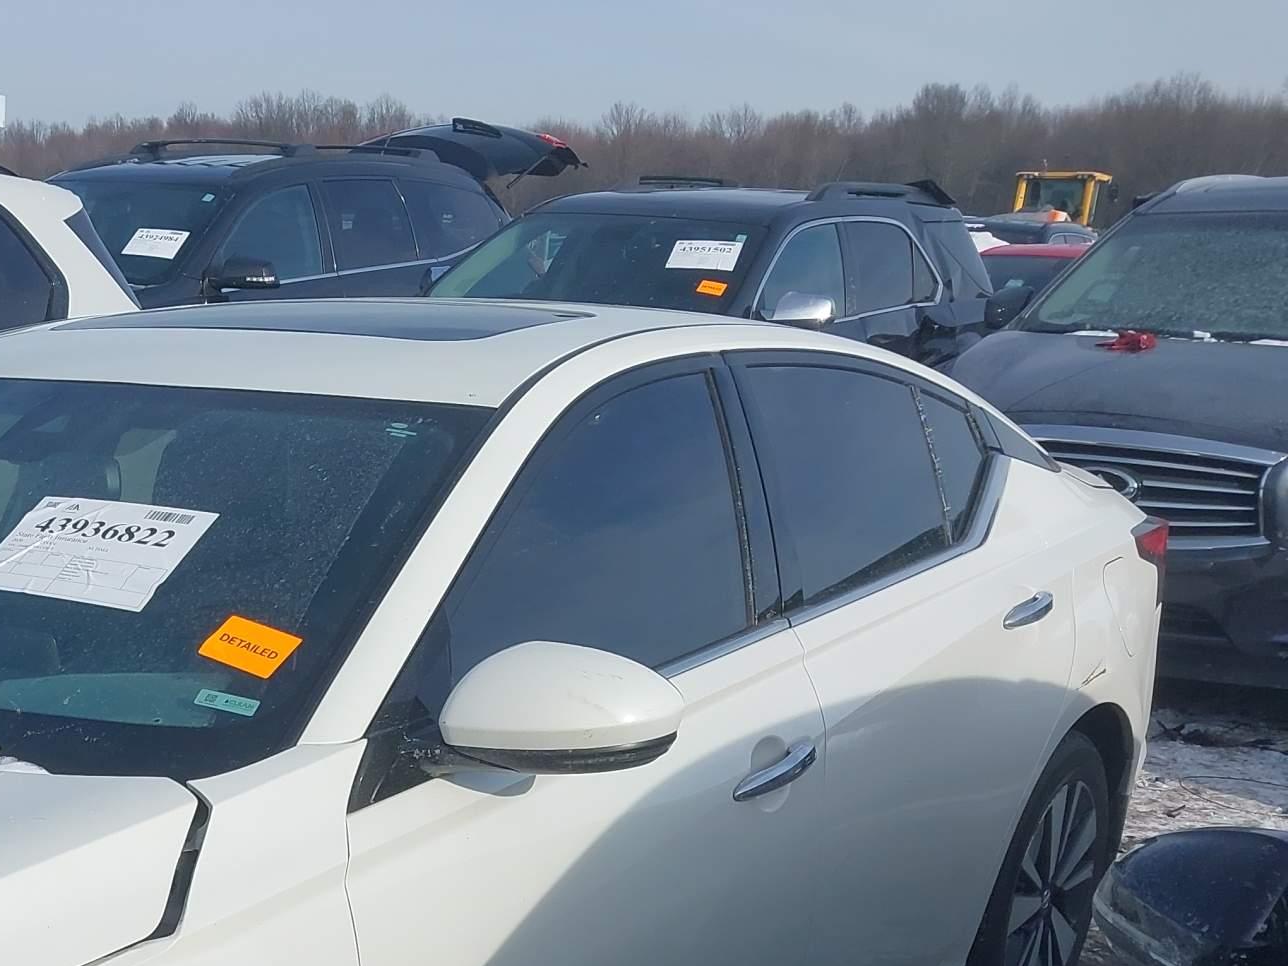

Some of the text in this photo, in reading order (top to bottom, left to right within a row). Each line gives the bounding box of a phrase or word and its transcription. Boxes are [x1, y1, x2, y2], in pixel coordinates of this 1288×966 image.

[679, 246, 733, 254] 43951502
[35, 516, 176, 548] 43936822
[218, 632, 280, 660] DETAILED
